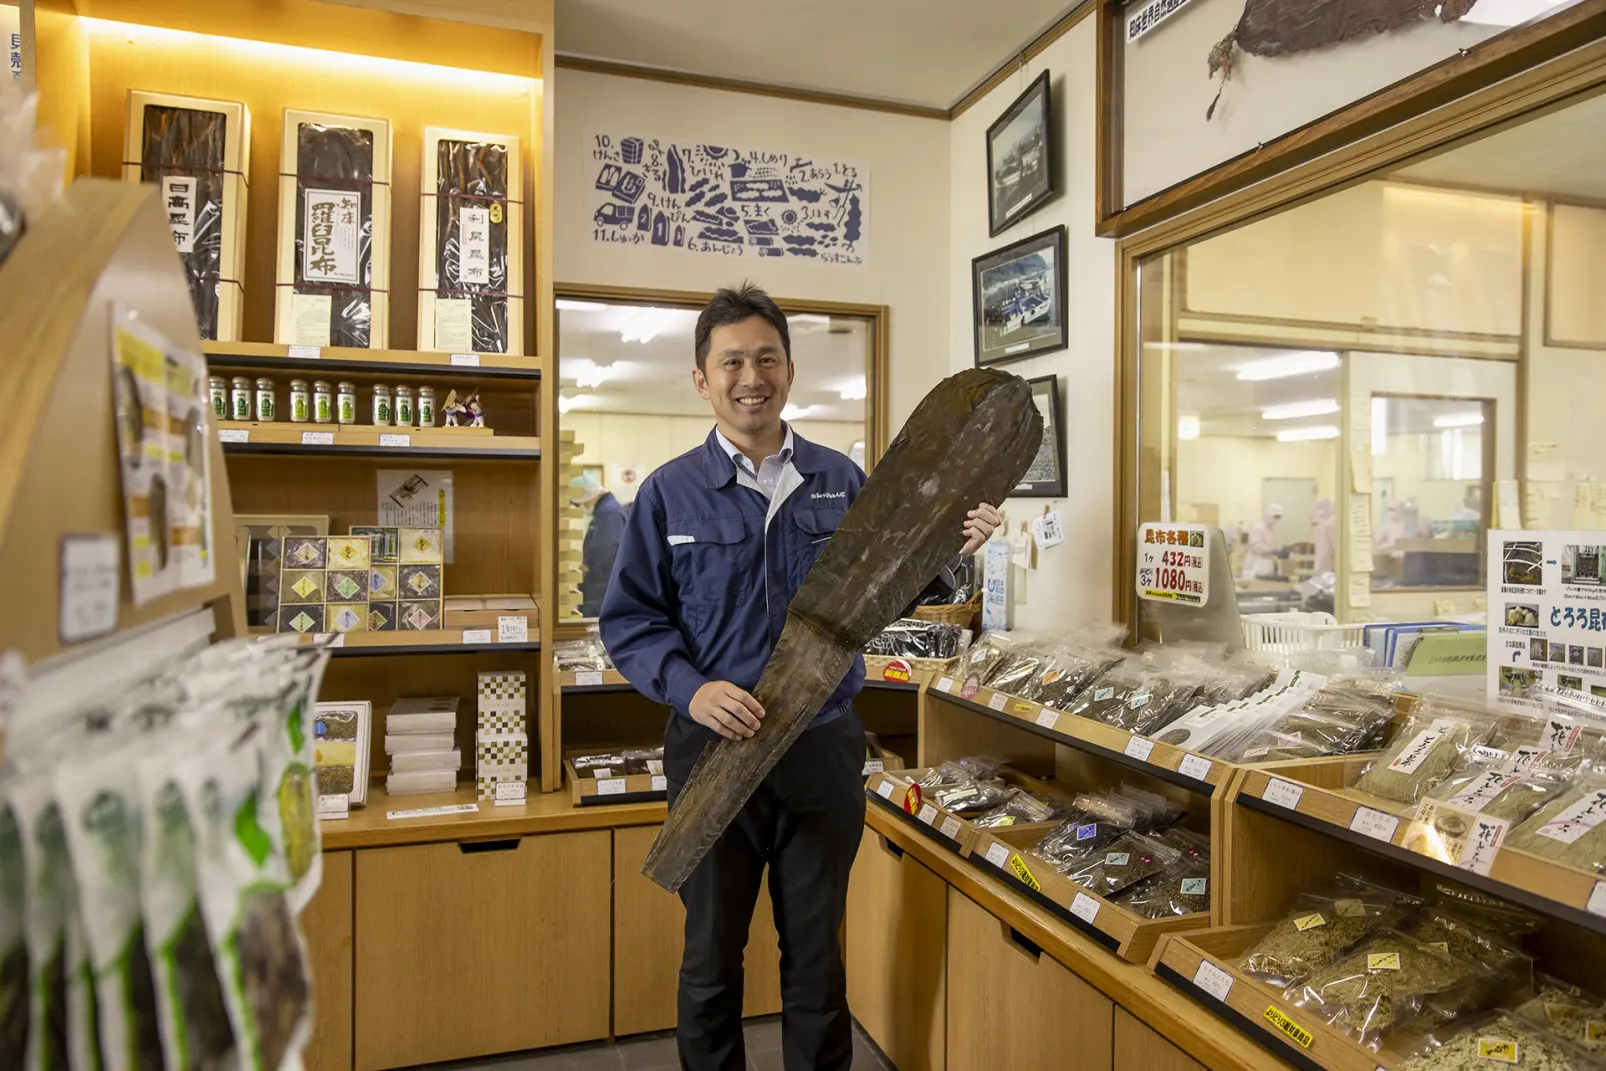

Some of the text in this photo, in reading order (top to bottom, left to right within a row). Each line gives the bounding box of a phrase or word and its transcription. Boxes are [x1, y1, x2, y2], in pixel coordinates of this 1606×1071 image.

[593, 150, 620, 162] けんさ
[799, 169, 831, 182] 2.あらう
[833, 163, 857, 177] 1.とる
[741, 203, 769, 217] 5.まく
[310, 202, 337, 276] 羅臼昆布
[468, 214, 484, 278] 利尻昆布
[1145, 529, 1188, 545] 昆布各種
